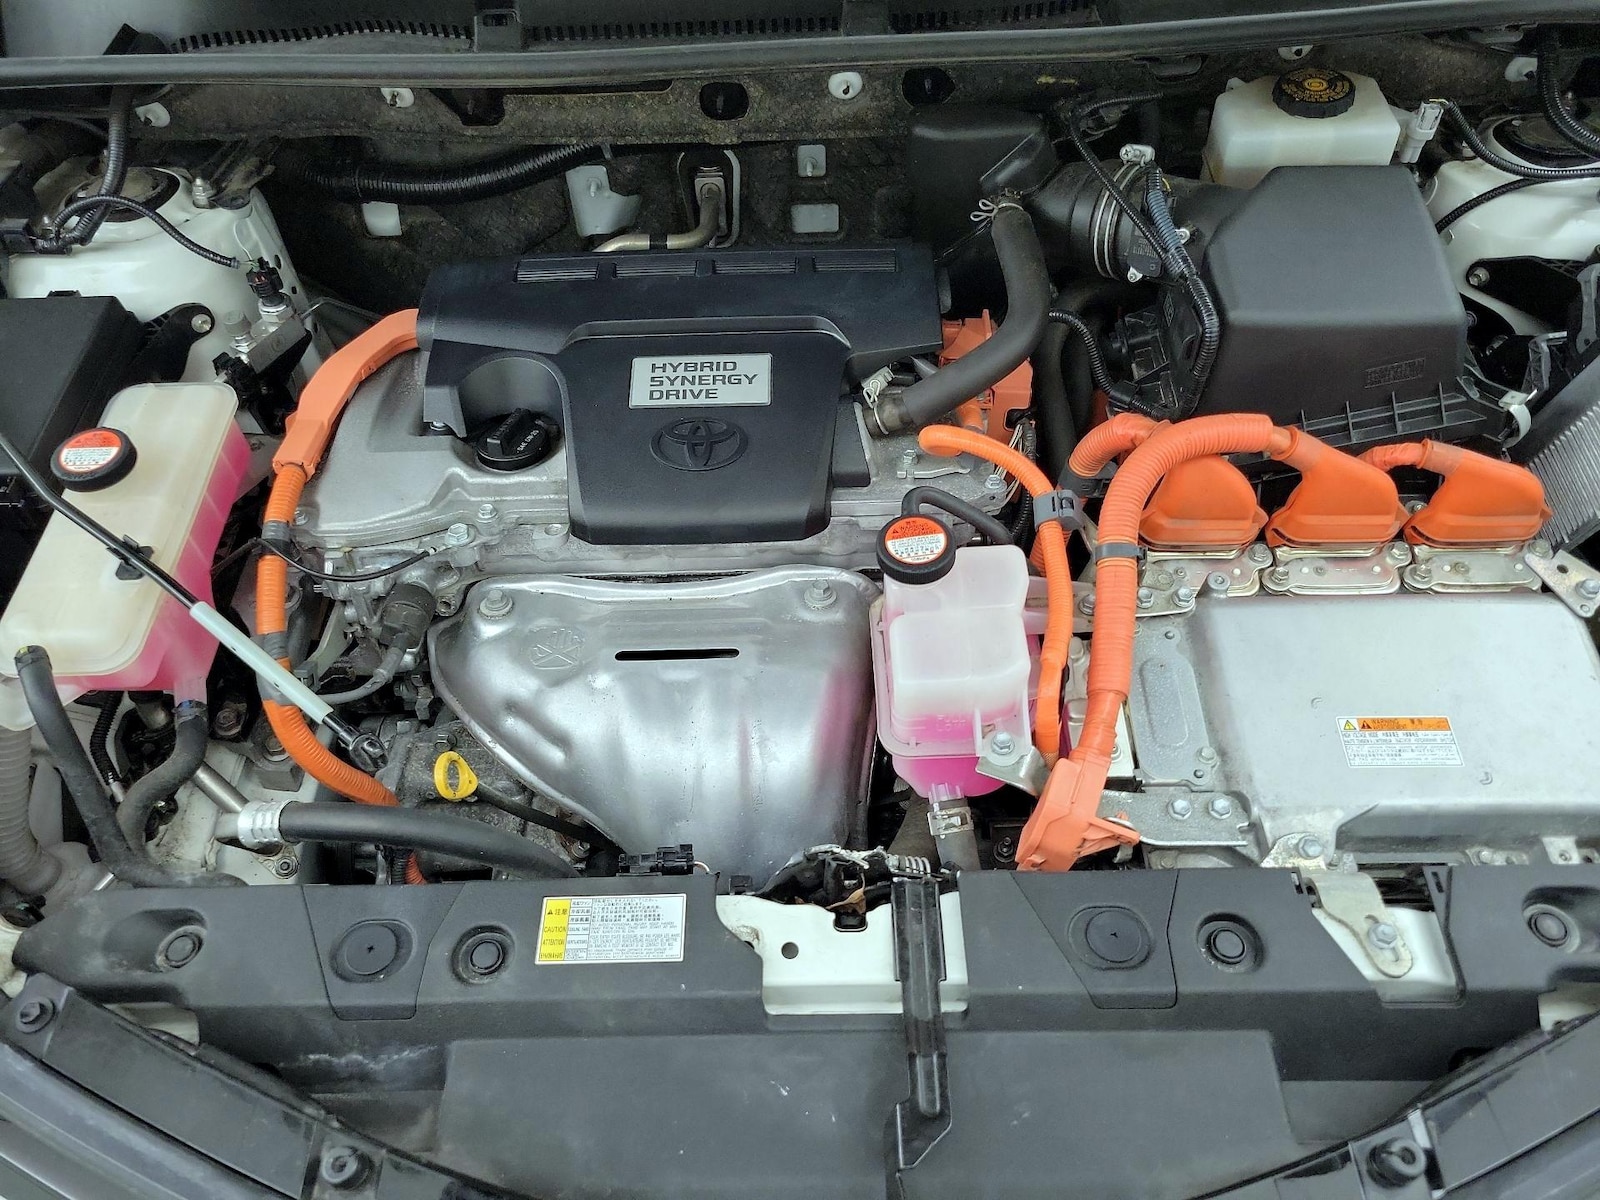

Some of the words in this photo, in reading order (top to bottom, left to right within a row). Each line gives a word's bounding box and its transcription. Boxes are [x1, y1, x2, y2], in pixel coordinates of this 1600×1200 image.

[651, 361, 737, 373] HYBRID
[649, 374, 758, 387] SYNERGY
[649, 388, 719, 400] DRIVE
